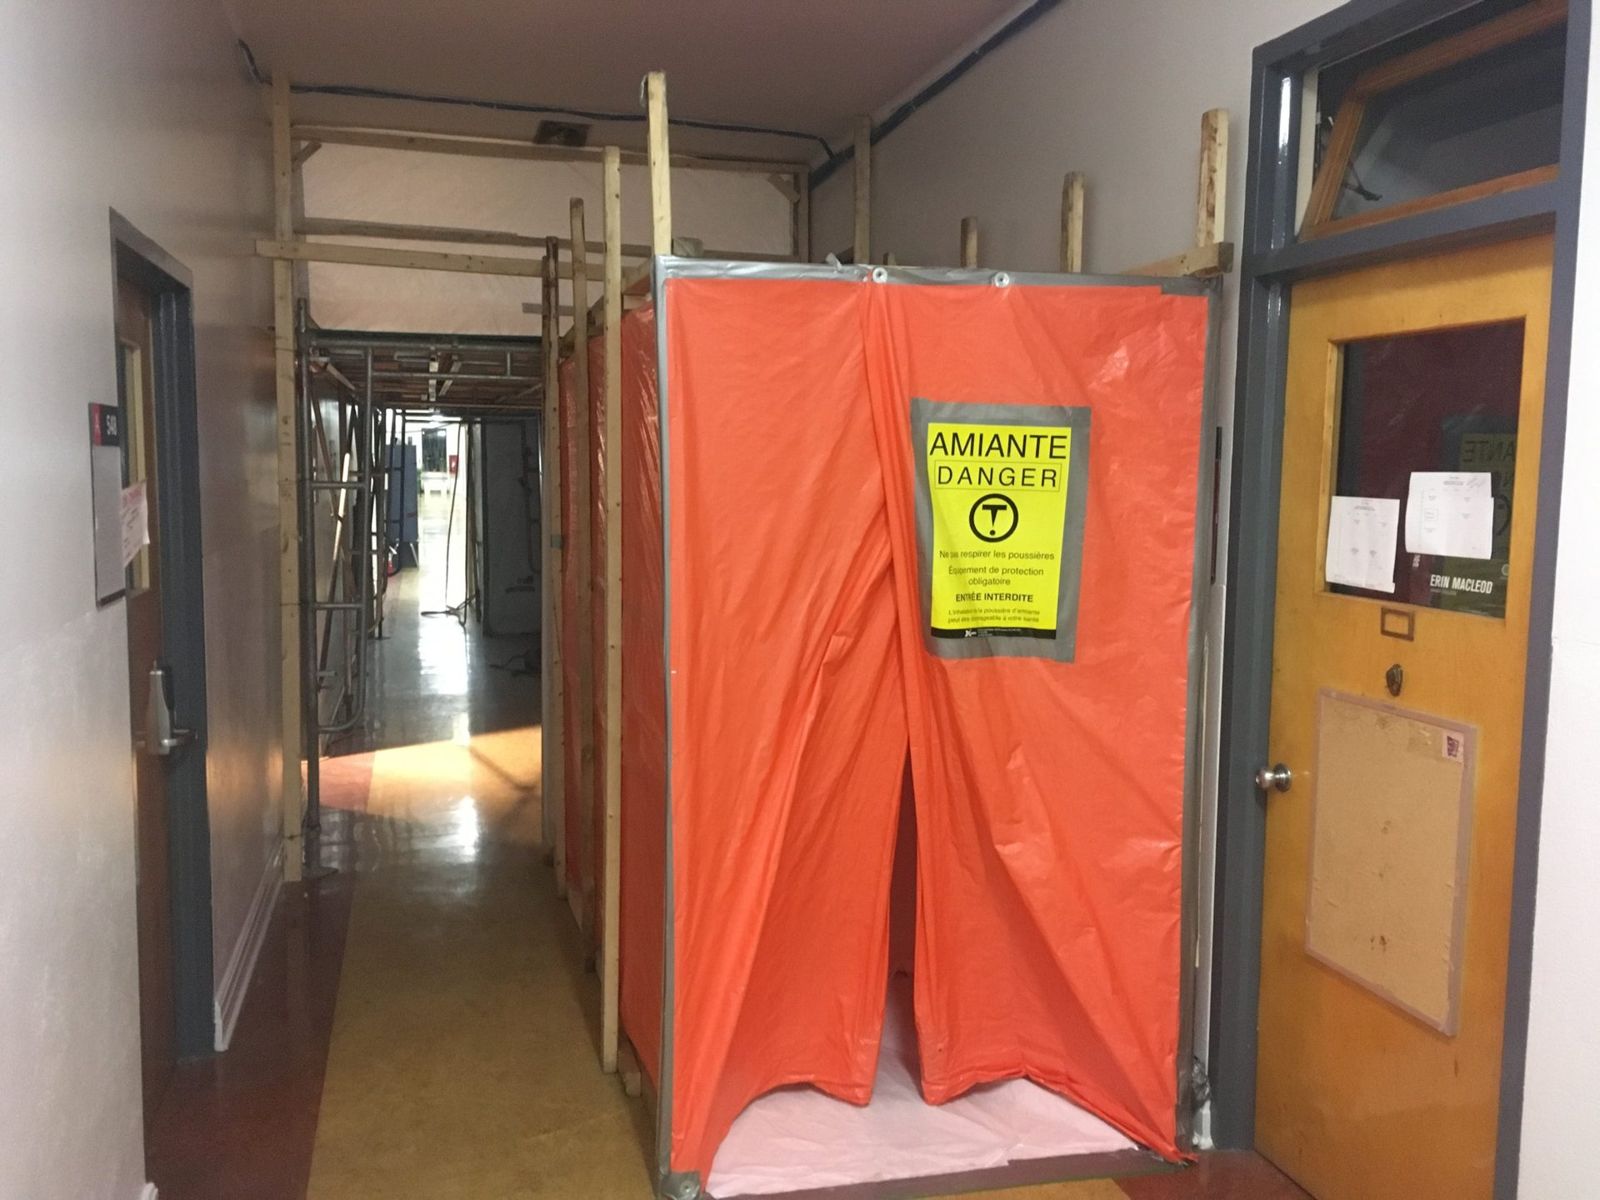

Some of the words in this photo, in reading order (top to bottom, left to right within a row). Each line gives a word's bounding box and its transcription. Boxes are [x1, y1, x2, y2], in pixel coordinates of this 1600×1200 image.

[929, 432, 1068, 459] AMIANTE
[937, 465, 1057, 488] DANGER
[960, 550, 991, 560] respirer
[993, 549, 1006, 559] les
[1008, 550, 1055, 561] poussières
[989, 566, 1000, 574] de
[1001, 567, 1044, 576] protection
[968, 577, 1011, 587] obligatoire
[1430, 574, 1450, 589] ERIN
[1451, 576, 1493, 594] MACLEOD
[955, 591, 982, 602] ENTRÉE
[984, 592, 1034, 603] INTERDITE
